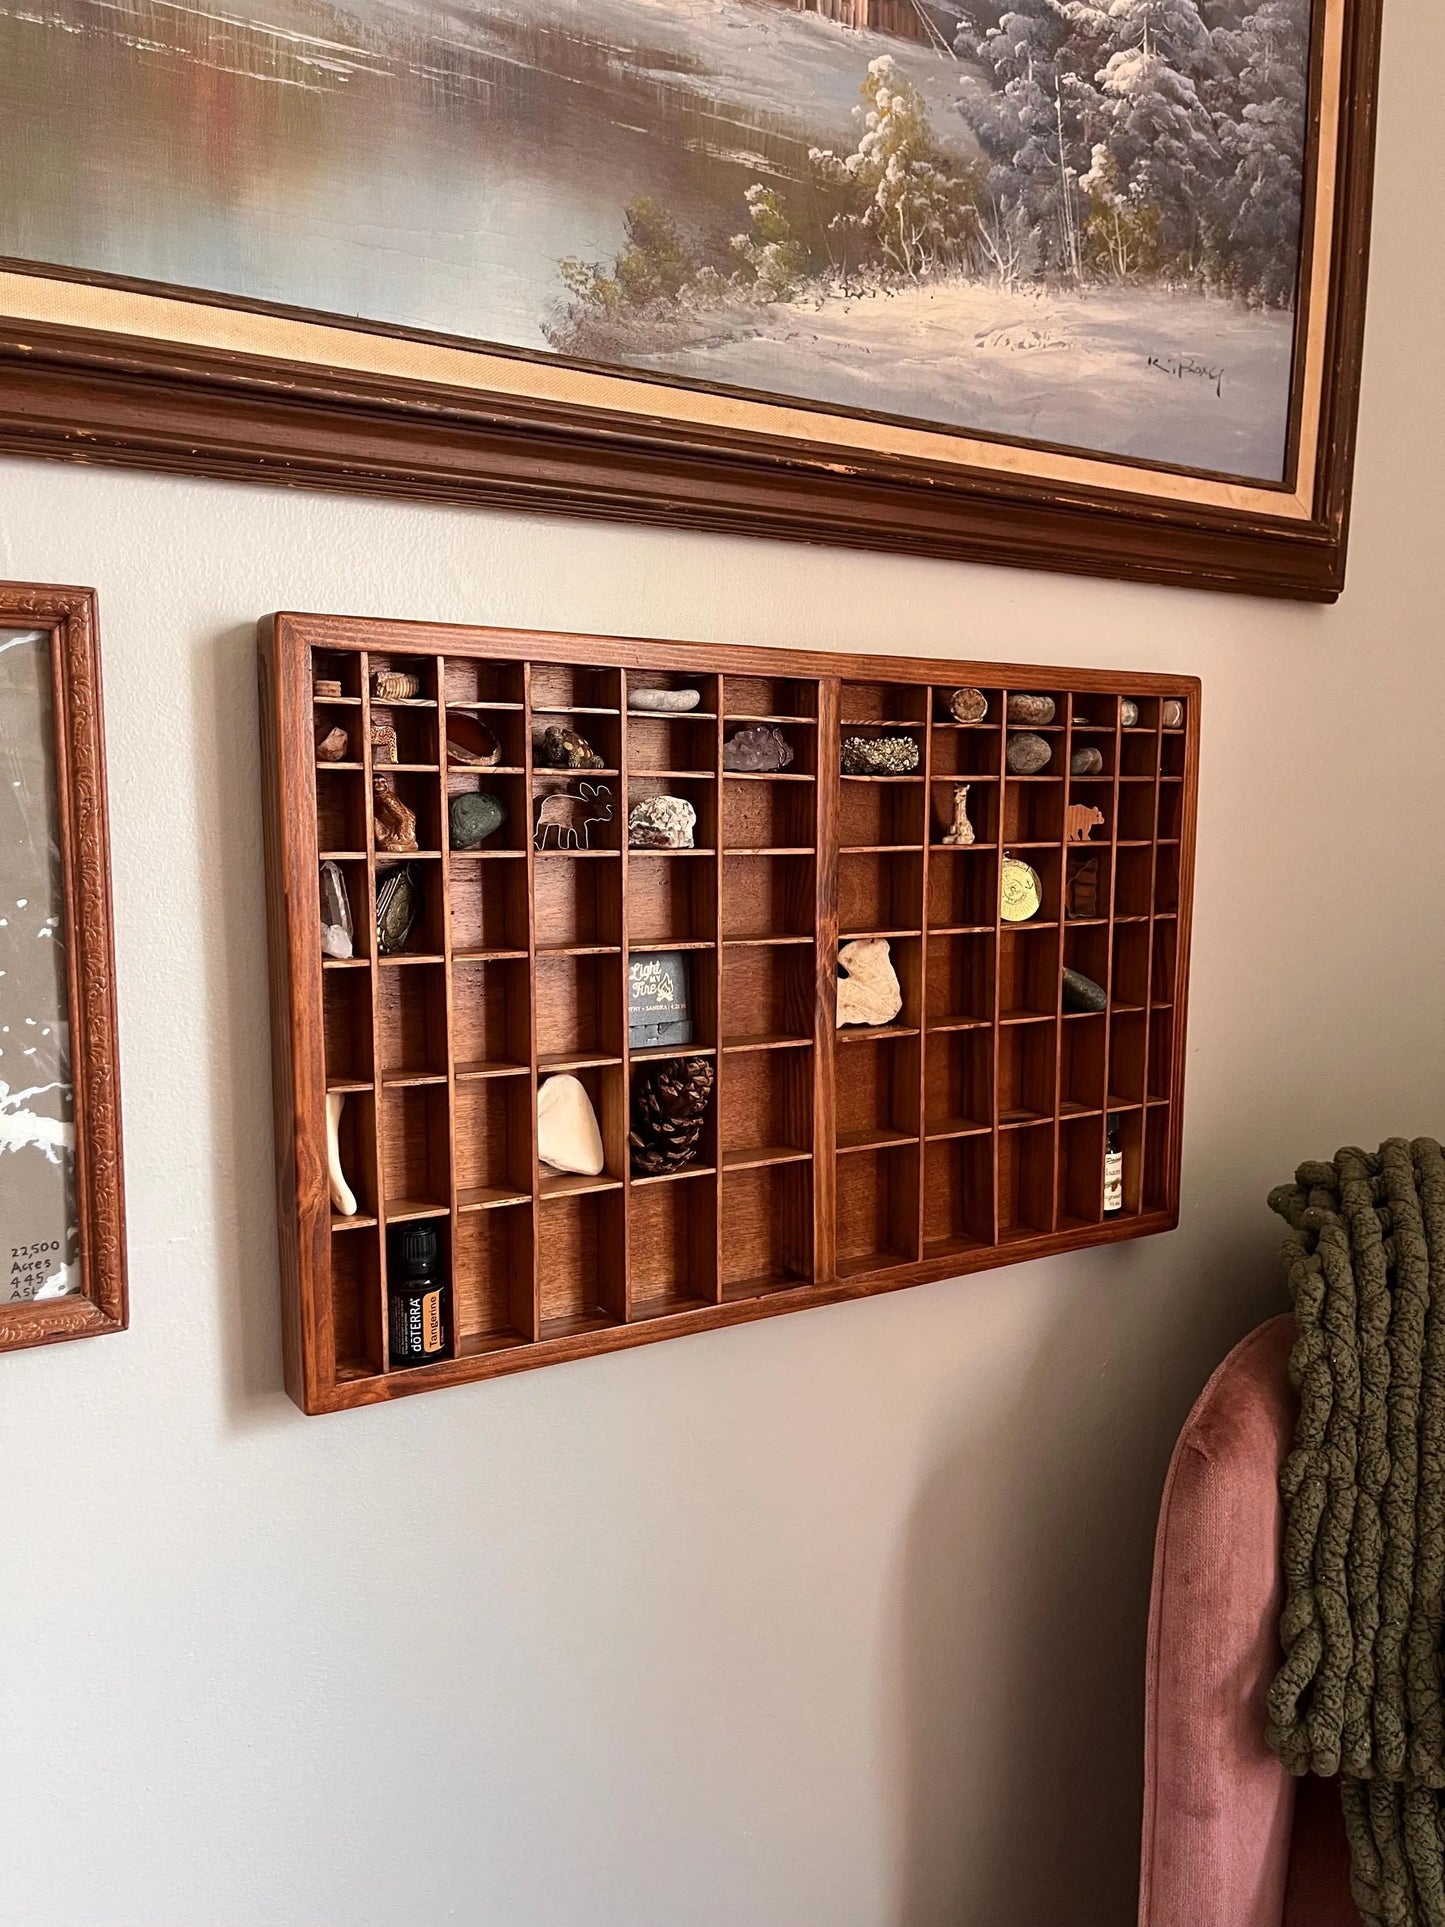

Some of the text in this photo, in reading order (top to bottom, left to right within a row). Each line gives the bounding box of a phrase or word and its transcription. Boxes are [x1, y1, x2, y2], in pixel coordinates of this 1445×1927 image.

[629, 960, 661, 981] Light
[632, 981, 658, 998] Fire
[11, 1240, 60, 1259] 22,500
[11, 1259, 52, 1274] Acres
[10, 1272, 45, 1288] 445
[429, 1296, 438, 1348] Tangerine
